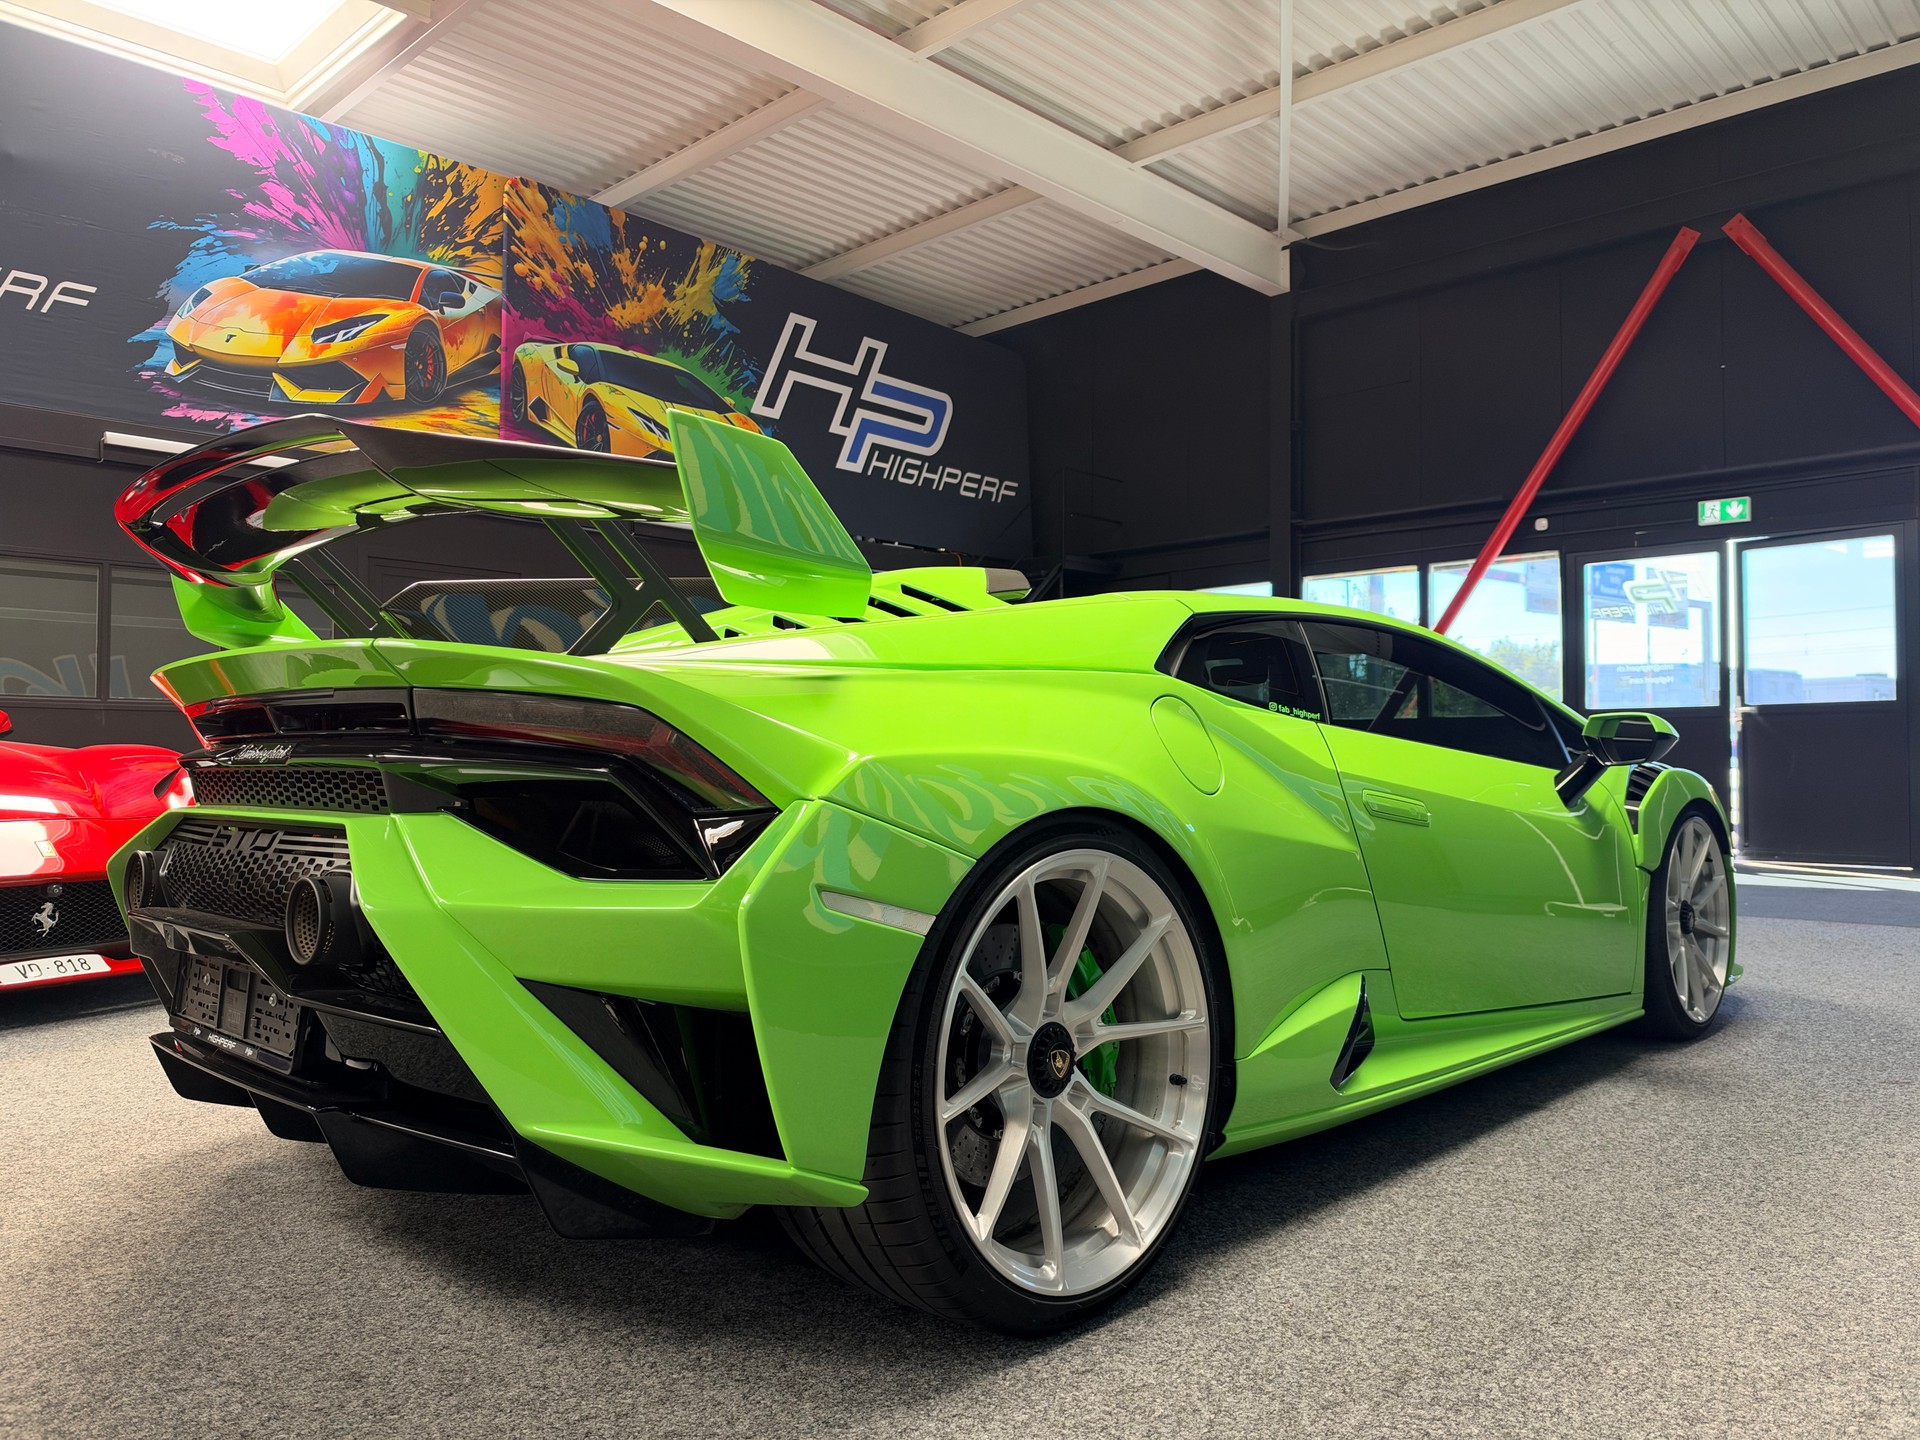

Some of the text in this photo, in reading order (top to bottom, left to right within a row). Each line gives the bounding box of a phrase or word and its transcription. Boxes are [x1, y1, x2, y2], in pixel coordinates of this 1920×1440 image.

[0, 267, 97, 313] RF
[751, 312, 953, 473] HP
[867, 450, 1019, 503] HIGHPERF
[1278, 704, 1321, 720] fab_highperf
[53, 957, 91, 974] 818
[207, 1032, 238, 1051] HIGHPERF
[914, 1154, 957, 1253] MICHELIN
